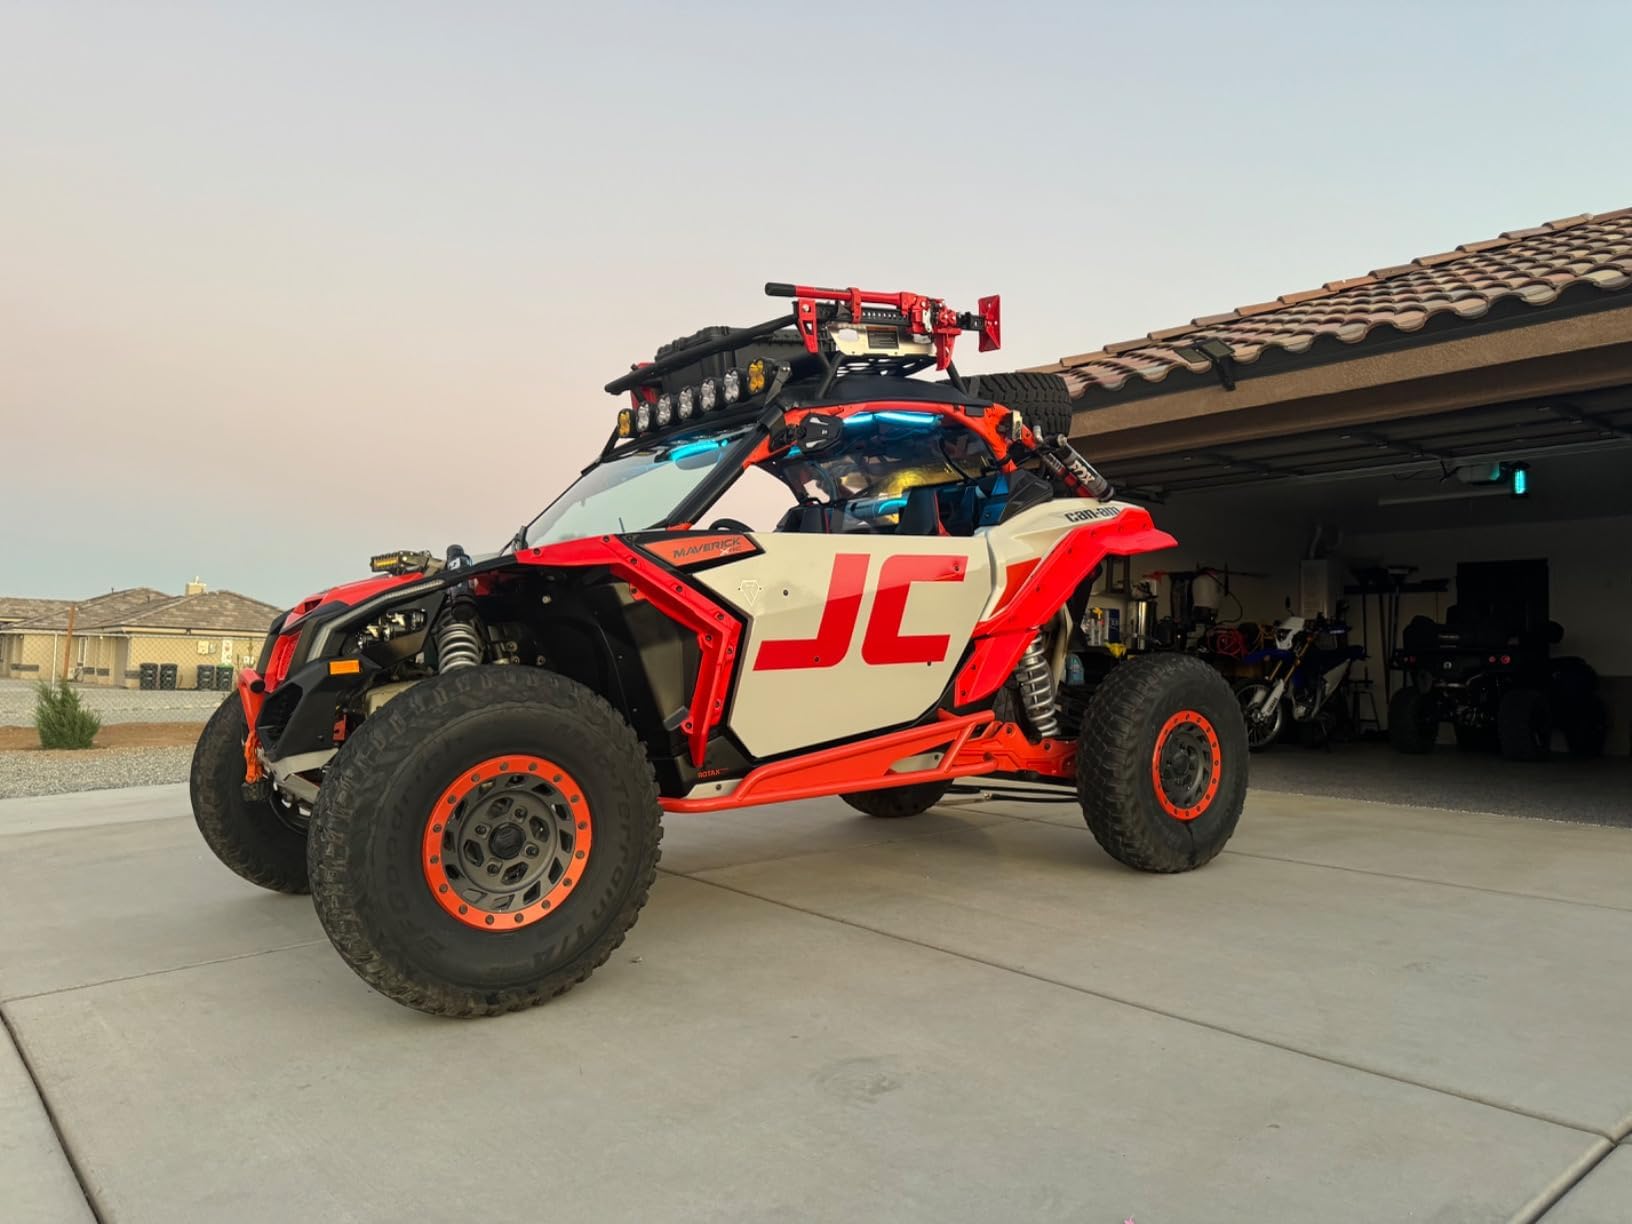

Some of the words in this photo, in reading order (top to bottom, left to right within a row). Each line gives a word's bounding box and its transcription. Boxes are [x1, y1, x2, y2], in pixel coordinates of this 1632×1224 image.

[1070, 460, 1095, 485] FOX
[1064, 506, 1120, 523] can-am
[674, 540, 740, 558] MAVERICK
[752, 553, 968, 671] JC
[697, 768, 720, 779] ROTAX
